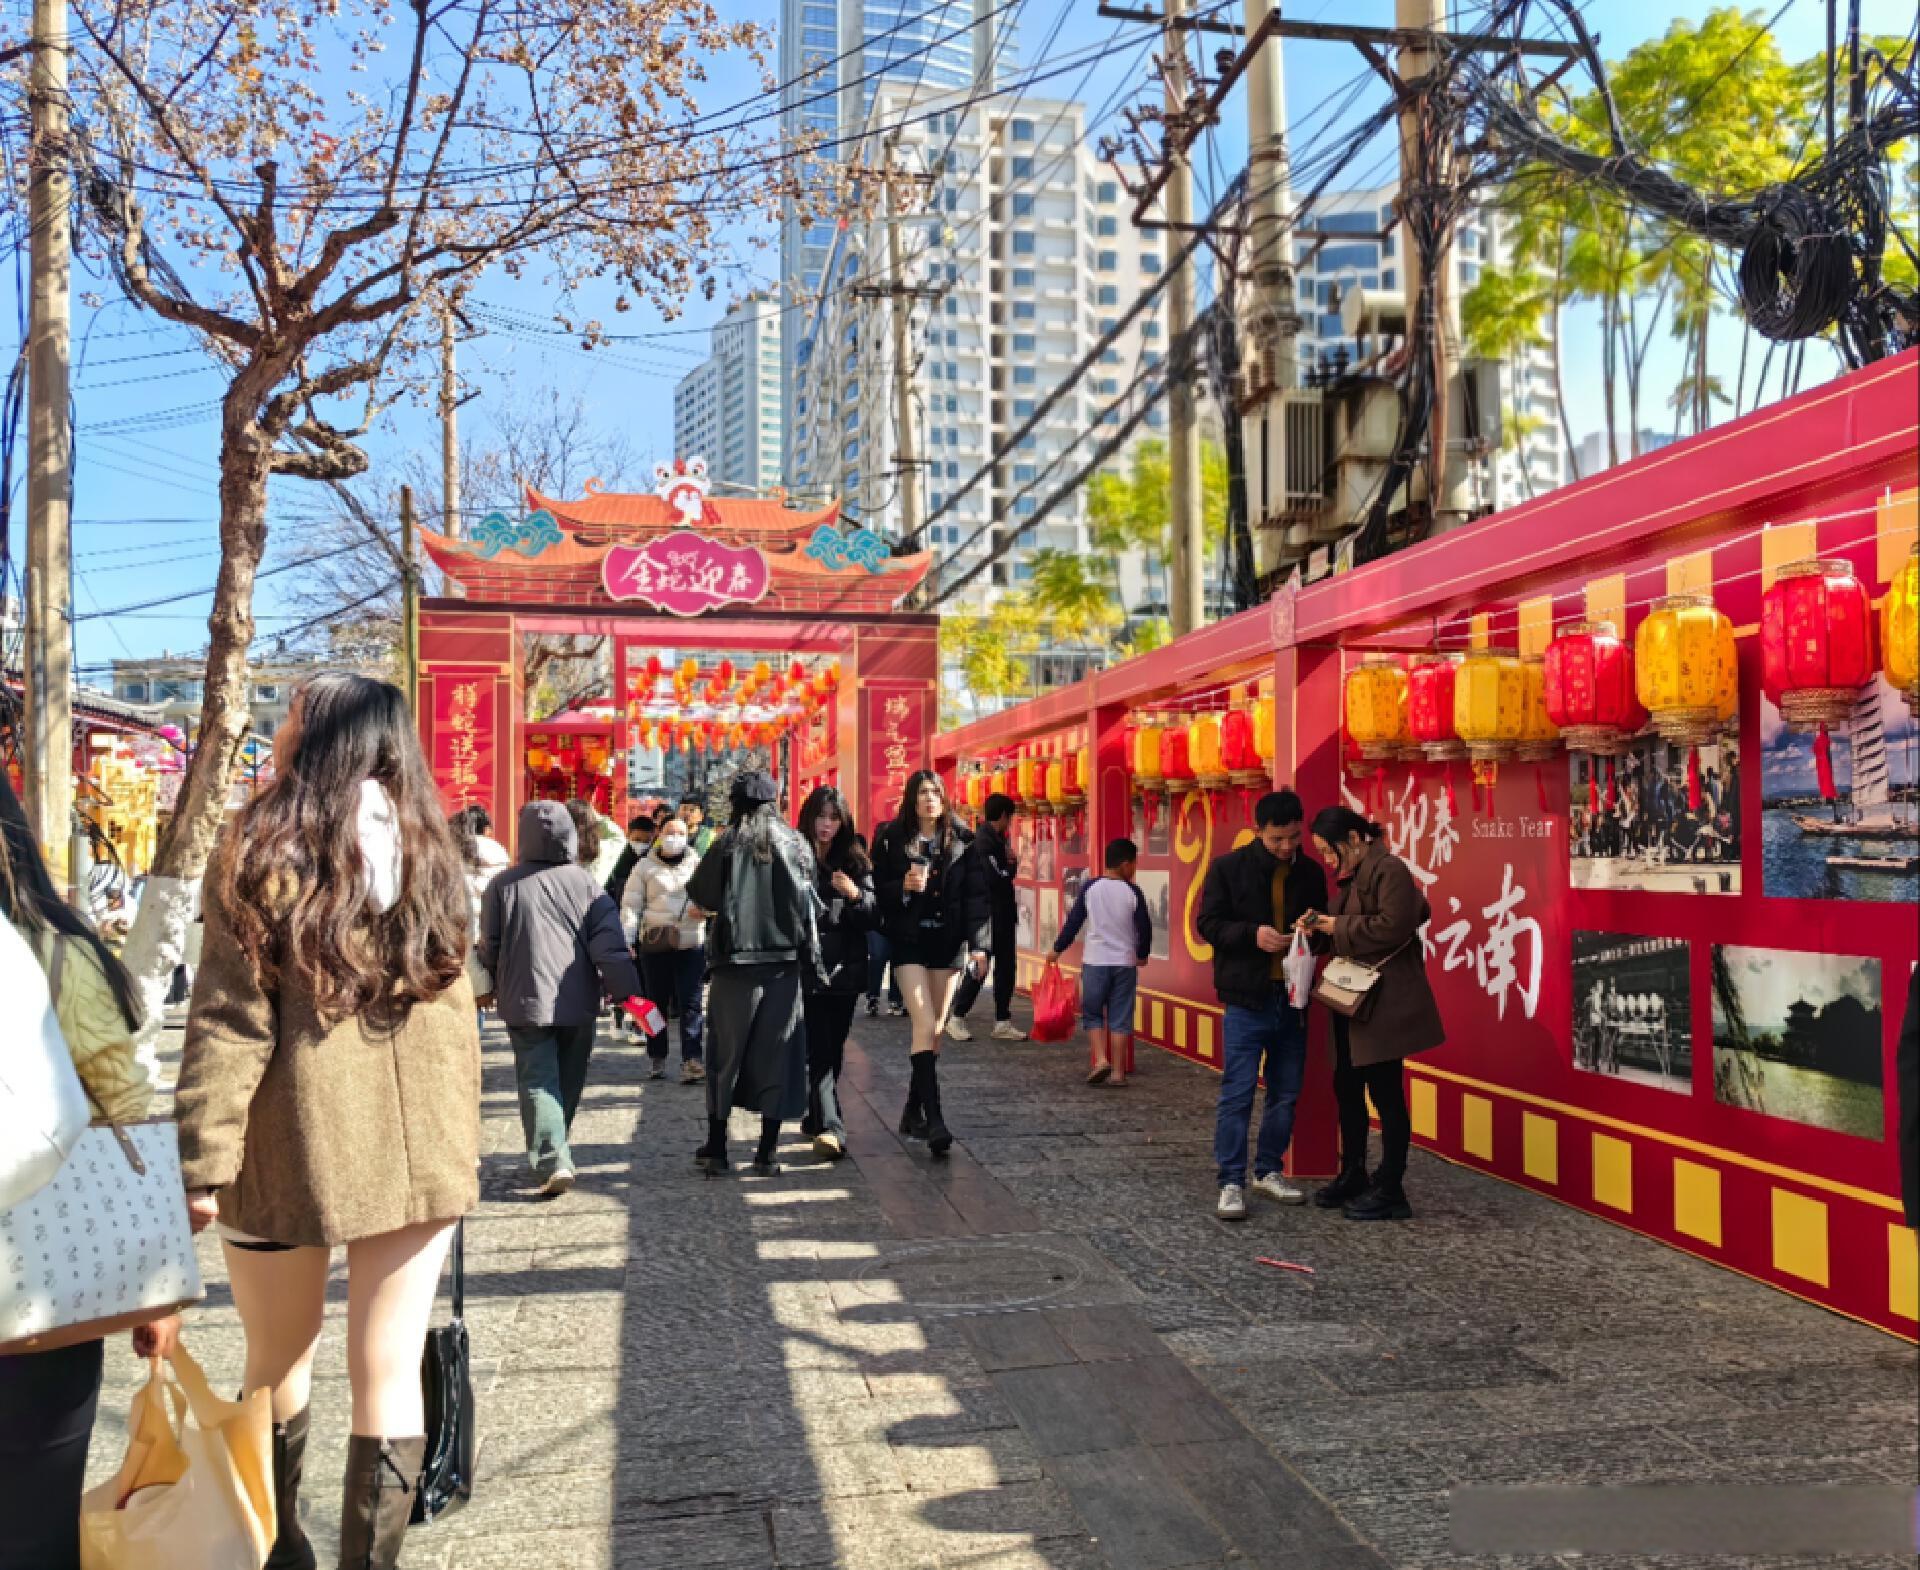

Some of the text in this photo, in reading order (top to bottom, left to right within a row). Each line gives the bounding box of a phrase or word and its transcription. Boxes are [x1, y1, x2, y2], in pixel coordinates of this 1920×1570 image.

[619, 550, 752, 599] 金蛇迎春
[1472, 816, 1553, 838] Snake Year
